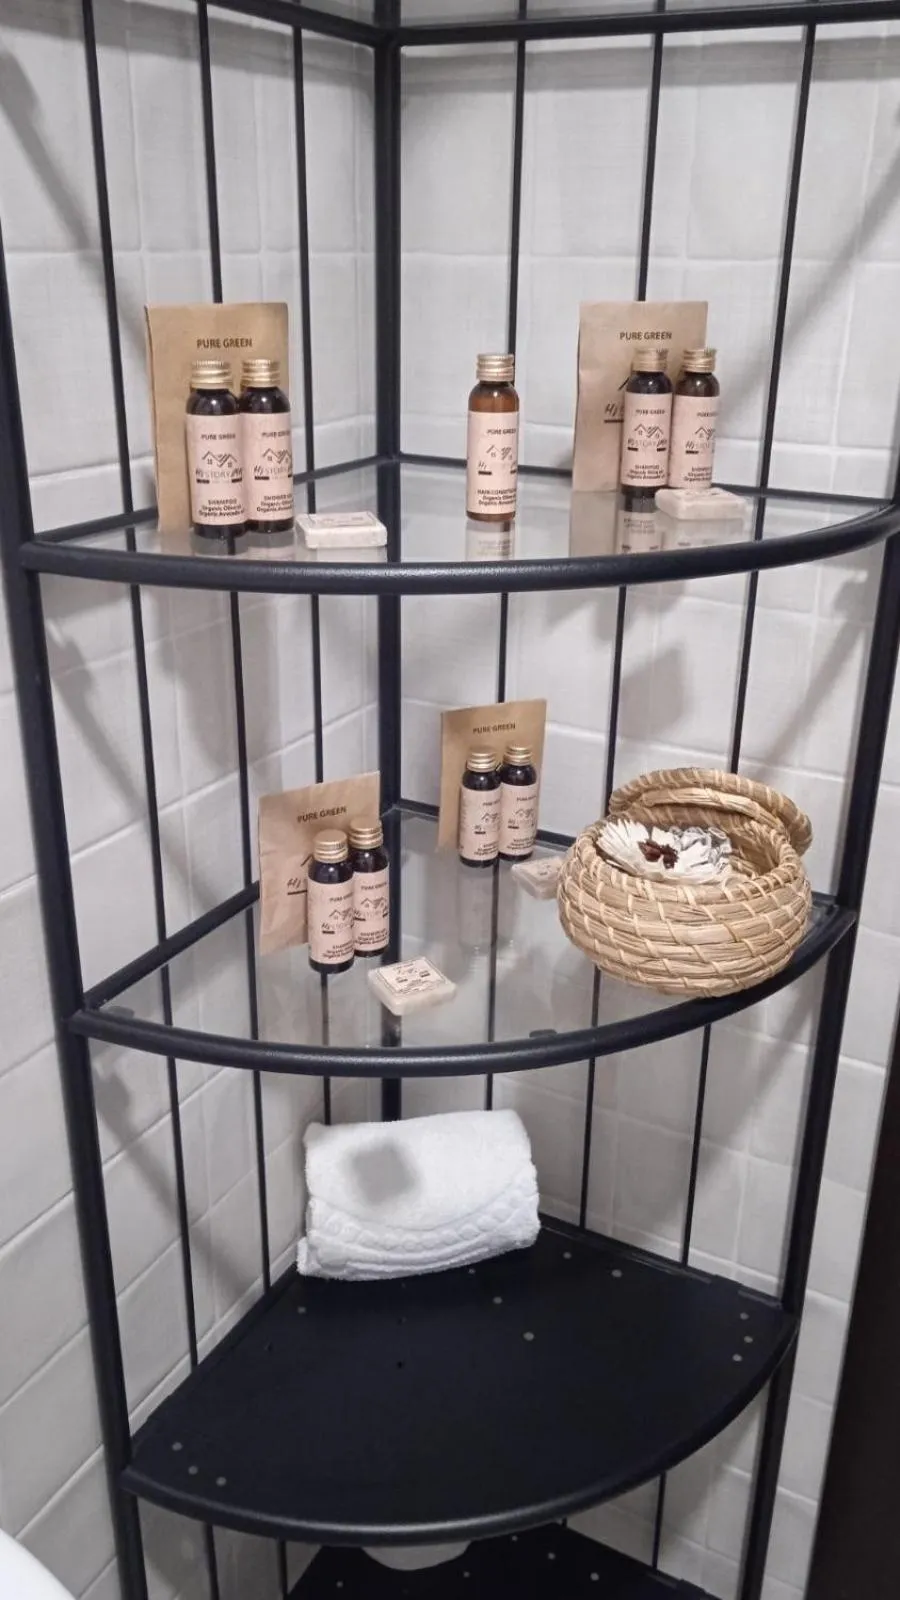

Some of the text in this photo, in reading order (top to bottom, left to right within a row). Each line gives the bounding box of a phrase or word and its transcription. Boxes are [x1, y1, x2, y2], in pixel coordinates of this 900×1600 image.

[620, 330, 673, 341] PURE GREEN
[196, 337, 253, 349] PURE GREEN
[218, 432, 236, 440] GREEN
[472, 723, 517, 735] PURE GREEN
[297, 806, 347, 823] PURE GREEN
